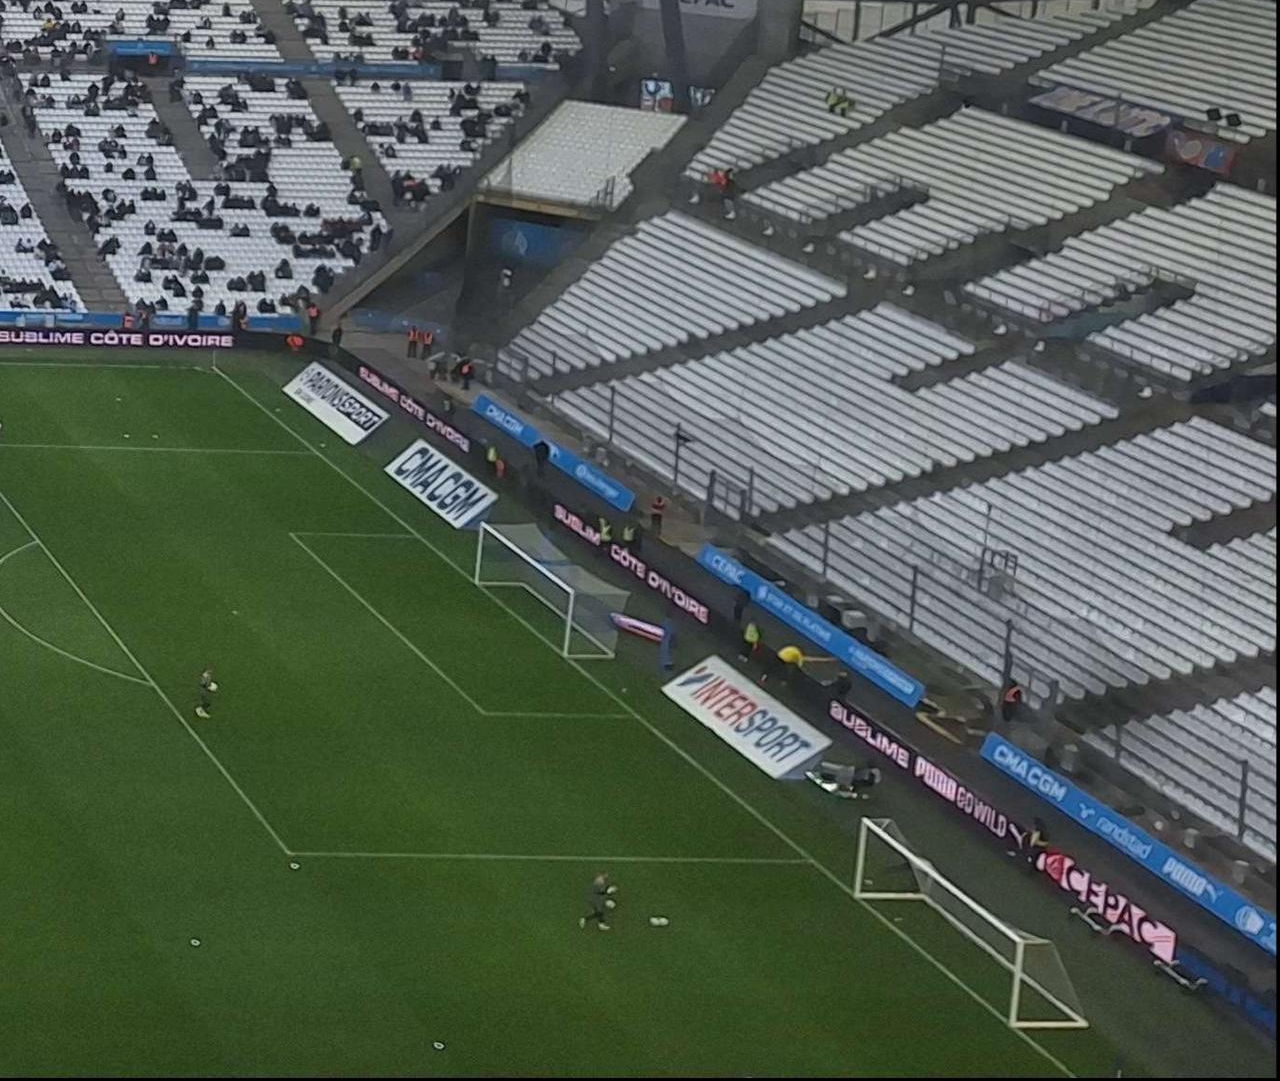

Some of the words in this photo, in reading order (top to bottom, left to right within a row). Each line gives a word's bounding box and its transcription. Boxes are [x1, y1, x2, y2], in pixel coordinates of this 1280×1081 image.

[90, 330, 144, 346] CÔTE
[149, 333, 233, 347] D'IVOIRE
[554, 503, 602, 547] SUBLIM
[611, 544, 647, 579] CÔTE
[647, 570, 710, 625] D'IVOIRE
[691, 675, 812, 763] INTERSPORT
[829, 700, 910, 769] SUBLIME
[993, 744, 1028, 780] CMA
[1026, 766, 1068, 803] CGM
[1162, 856, 1208, 896] PUMA
